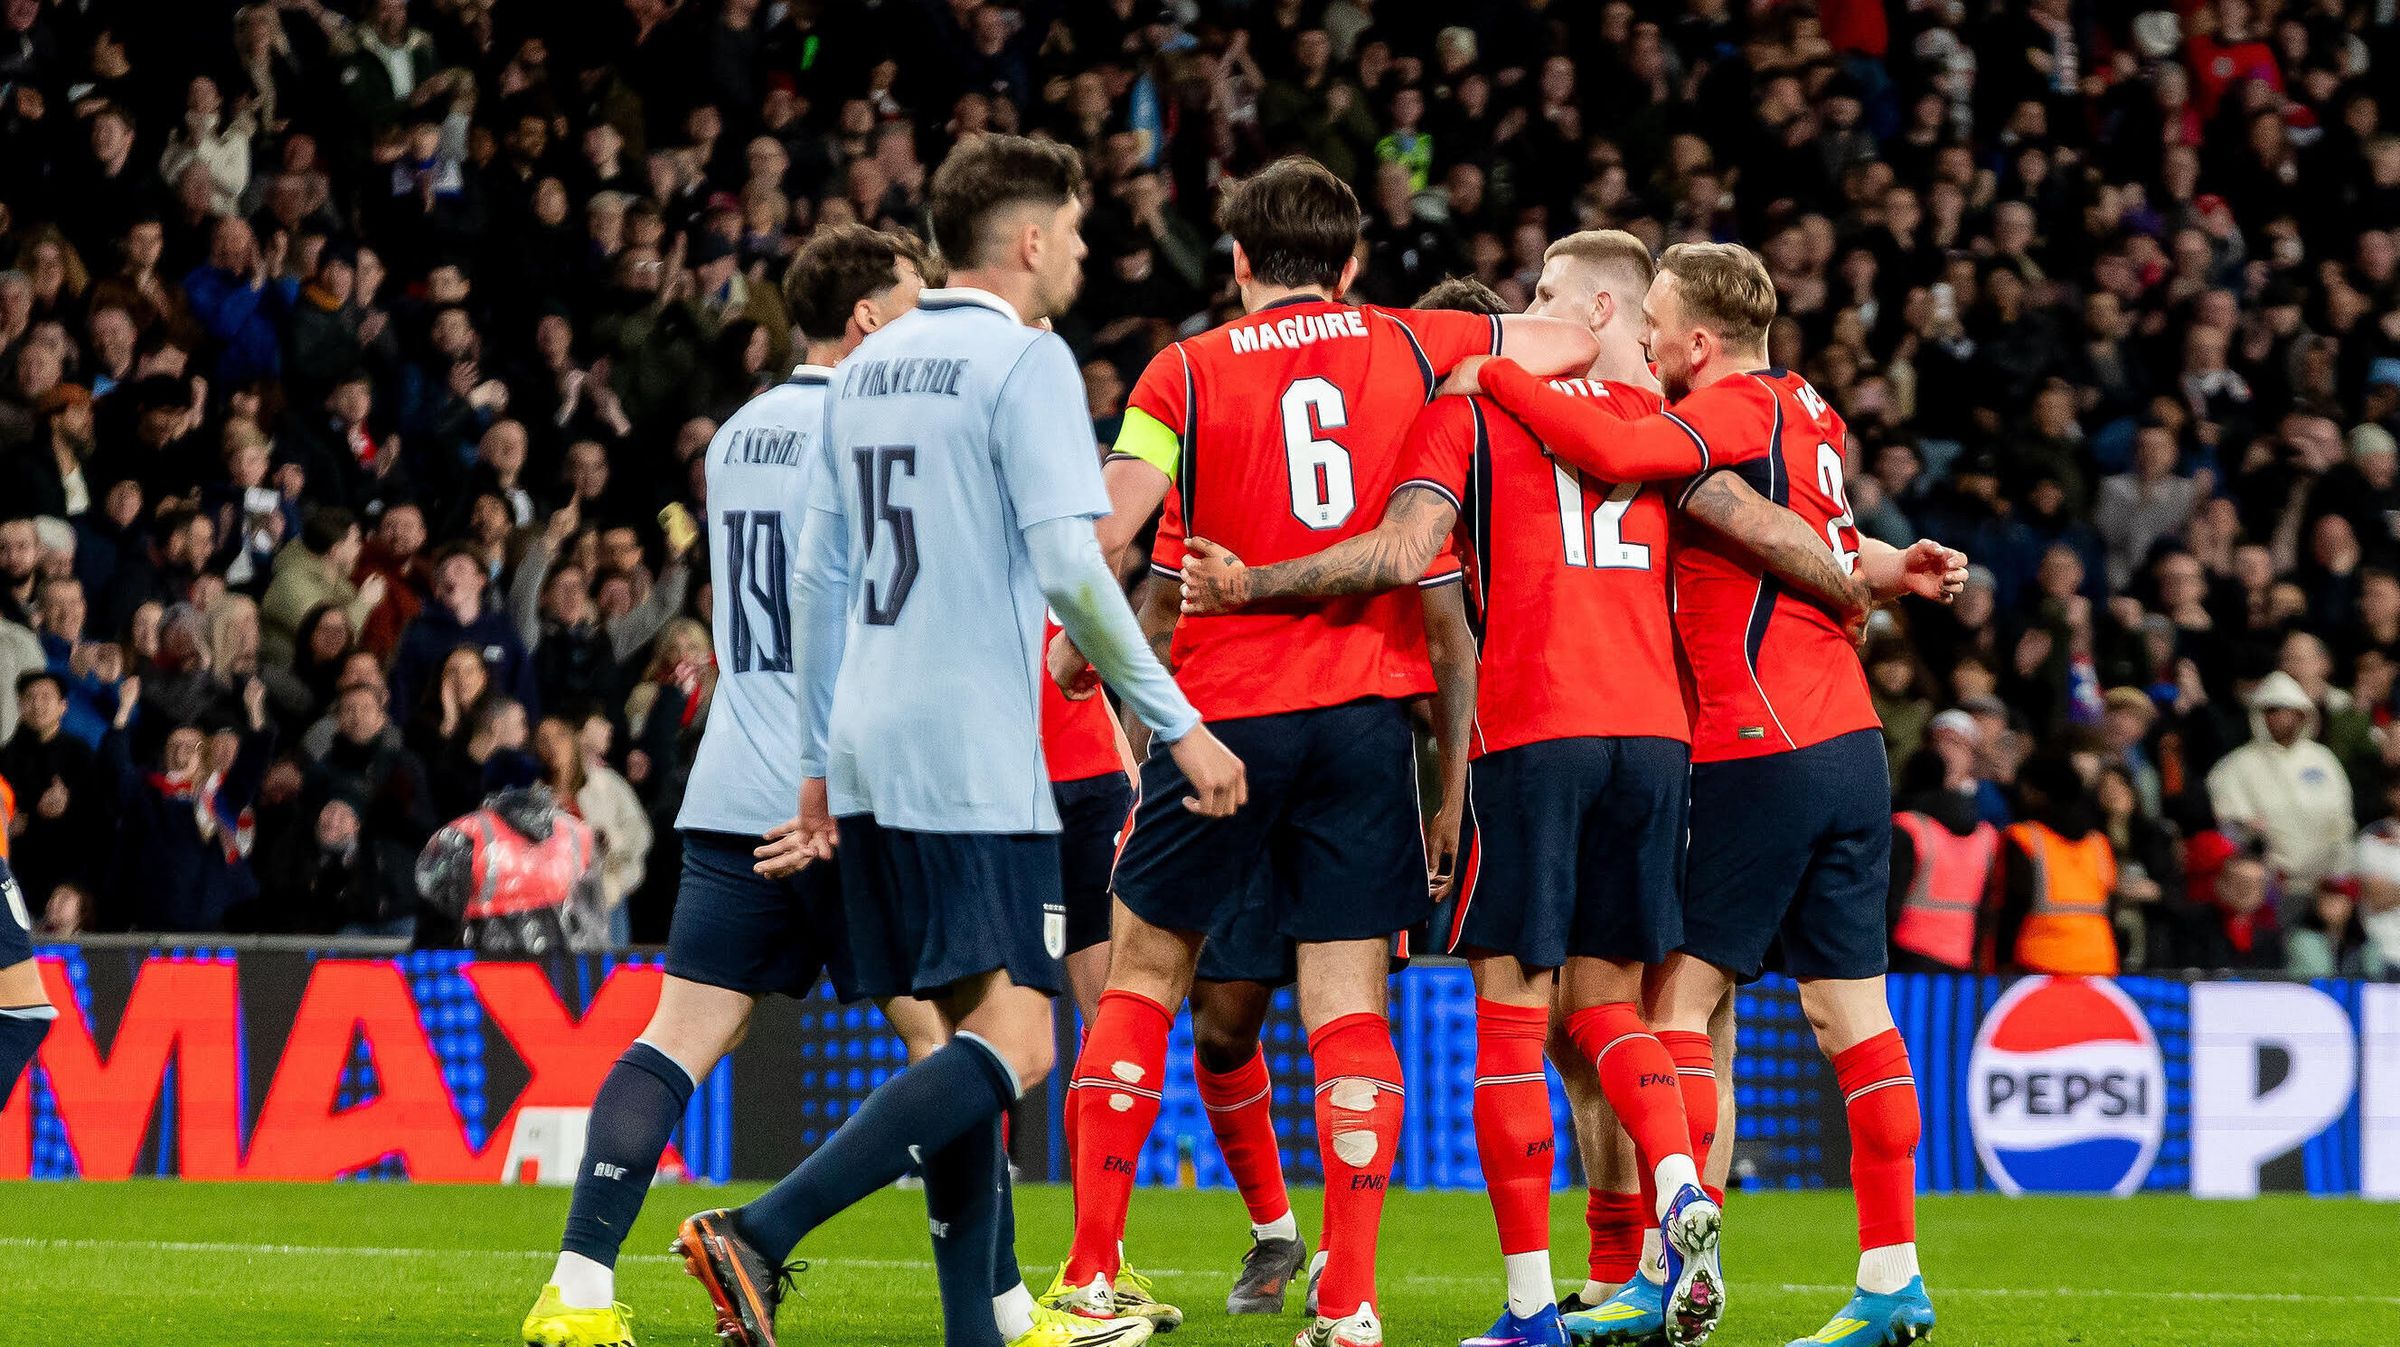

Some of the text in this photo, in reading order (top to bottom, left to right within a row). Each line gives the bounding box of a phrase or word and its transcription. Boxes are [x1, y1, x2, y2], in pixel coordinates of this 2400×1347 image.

[1228, 310, 1369, 356] MAGUIRE
[1280, 375, 1358, 531] 6
[852, 444, 920, 627] 15
[1553, 458, 1652, 570] 12
[722, 510, 794, 674] 19
[0, 958, 698, 1181] MAX
[1640, 1072, 1676, 1089] ENG
[1986, 1070, 2148, 1116] PEPSI
[1351, 1173, 1387, 1191] ENG
